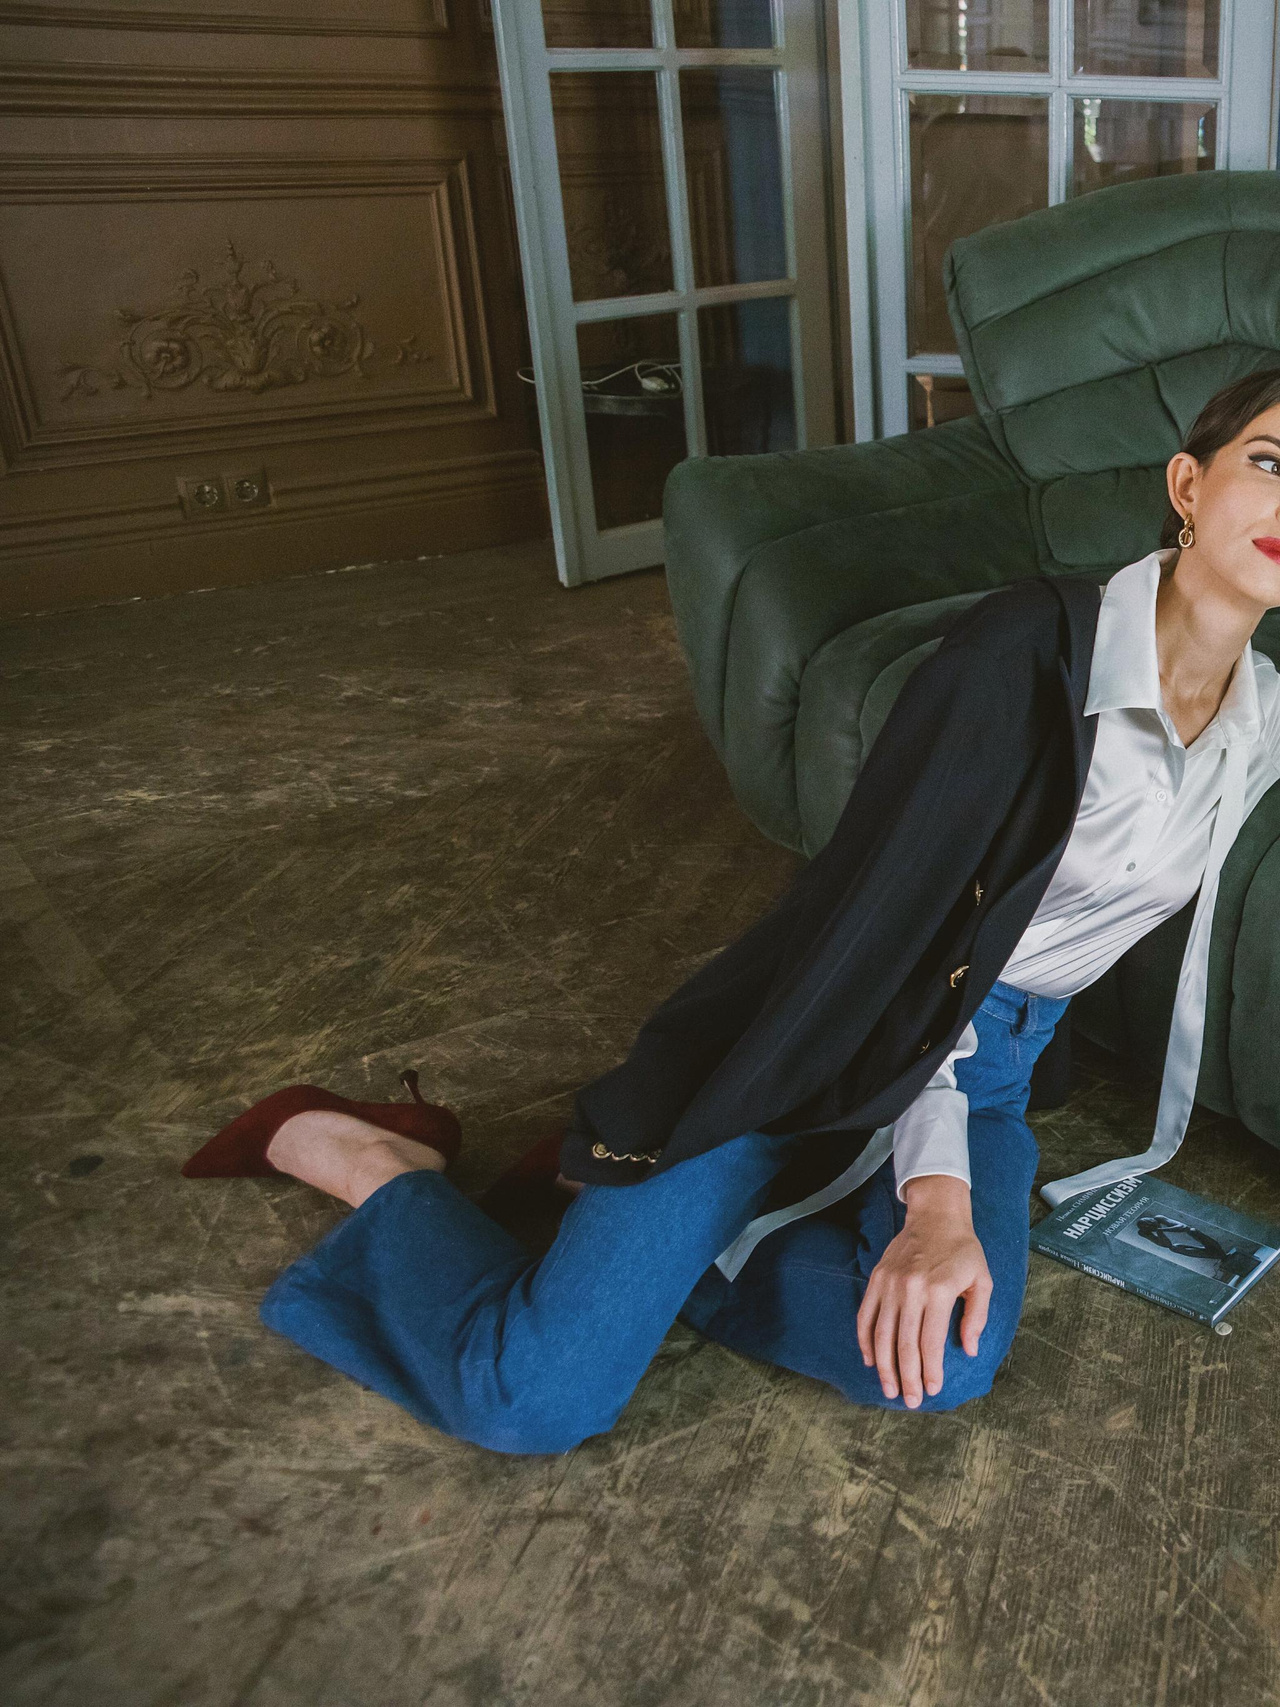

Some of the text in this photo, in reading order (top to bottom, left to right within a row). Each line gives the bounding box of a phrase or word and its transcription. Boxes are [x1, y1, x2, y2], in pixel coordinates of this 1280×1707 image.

[1063, 1176, 1143, 1240] НАРЦИССИЗМ
[1103, 1196, 1150, 1236] НОВАЯ ТЕОРИЯ
